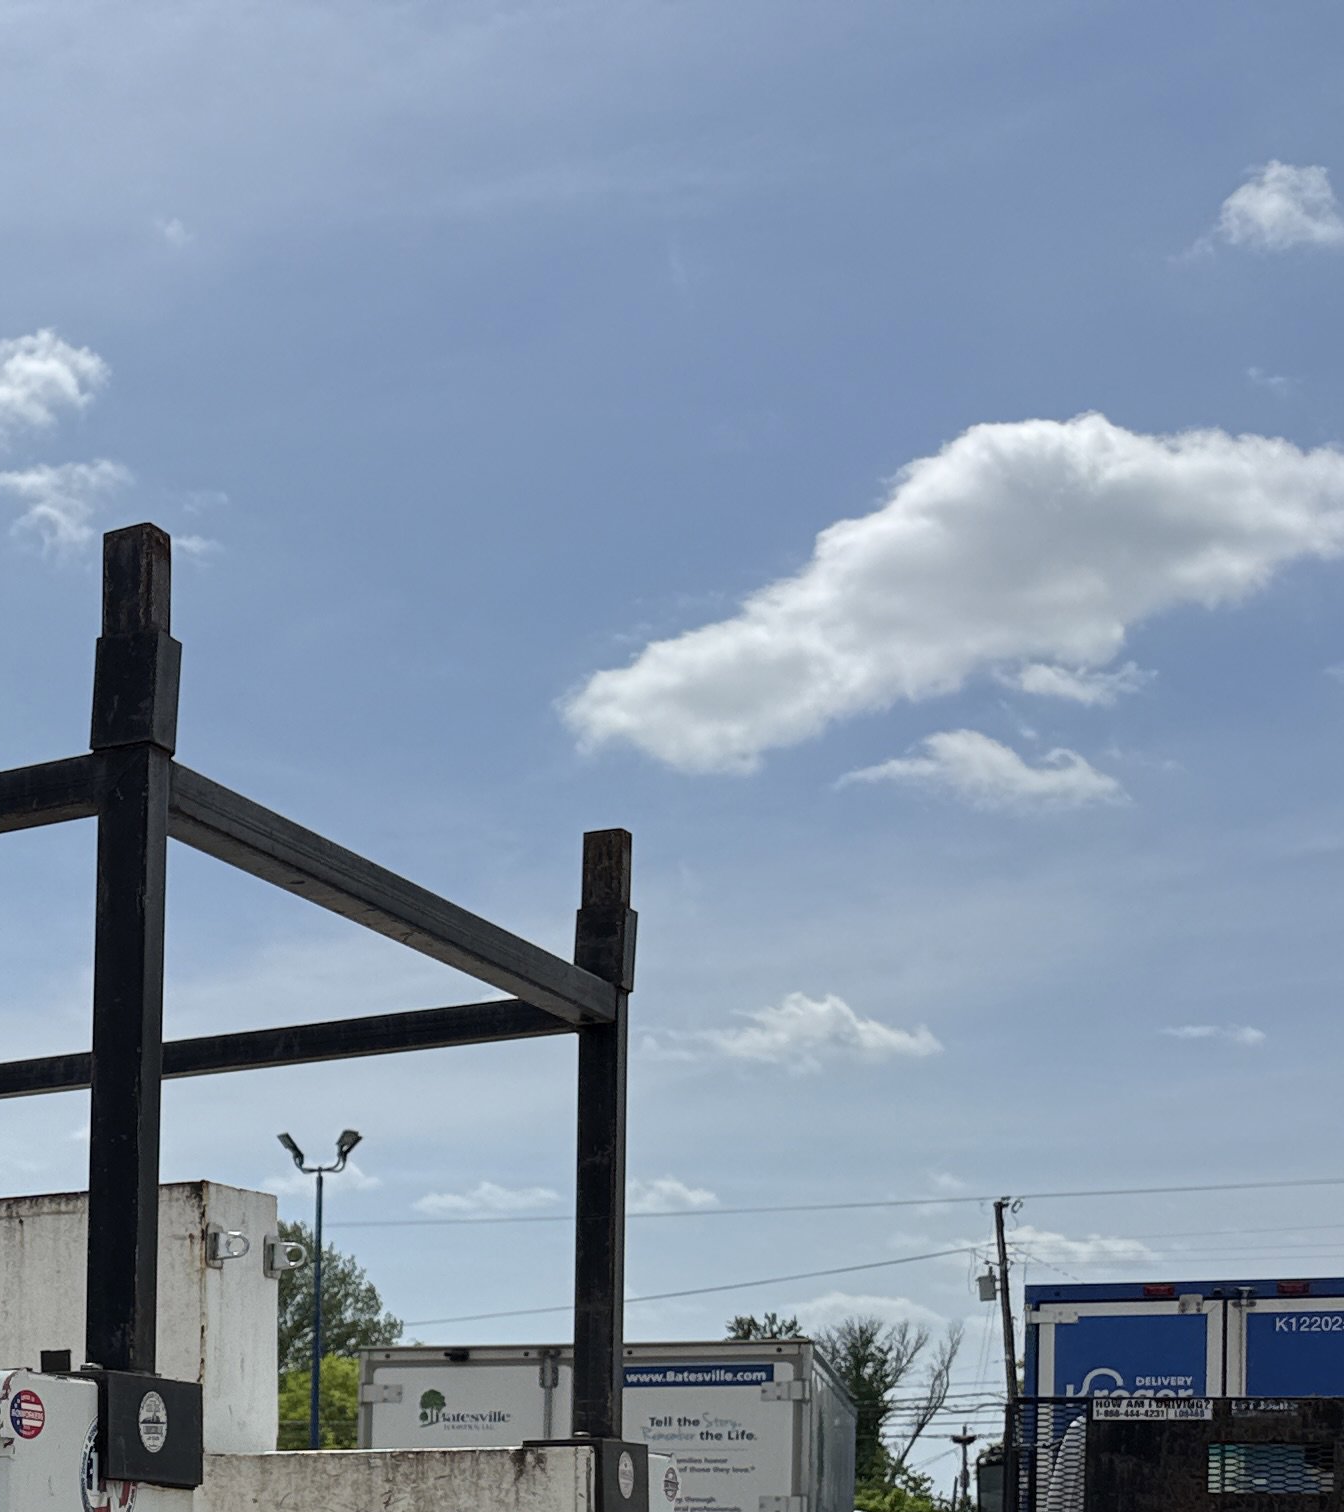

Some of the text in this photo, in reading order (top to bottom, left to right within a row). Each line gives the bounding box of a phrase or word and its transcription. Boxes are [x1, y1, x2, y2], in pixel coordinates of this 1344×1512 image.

[1275, 1316, 1344, 1332] K12202
[626, 1369, 767, 1383] www.Batesville.com
[1135, 1376, 1193, 1386] DELIVERY
[1095, 1399, 1122, 1409] HOW
[1126, 1399, 1145, 1409] AM
[649, 1416, 673, 1427] Tell
[677, 1416, 701, 1427] the
[699, 1430, 724, 1441] the
